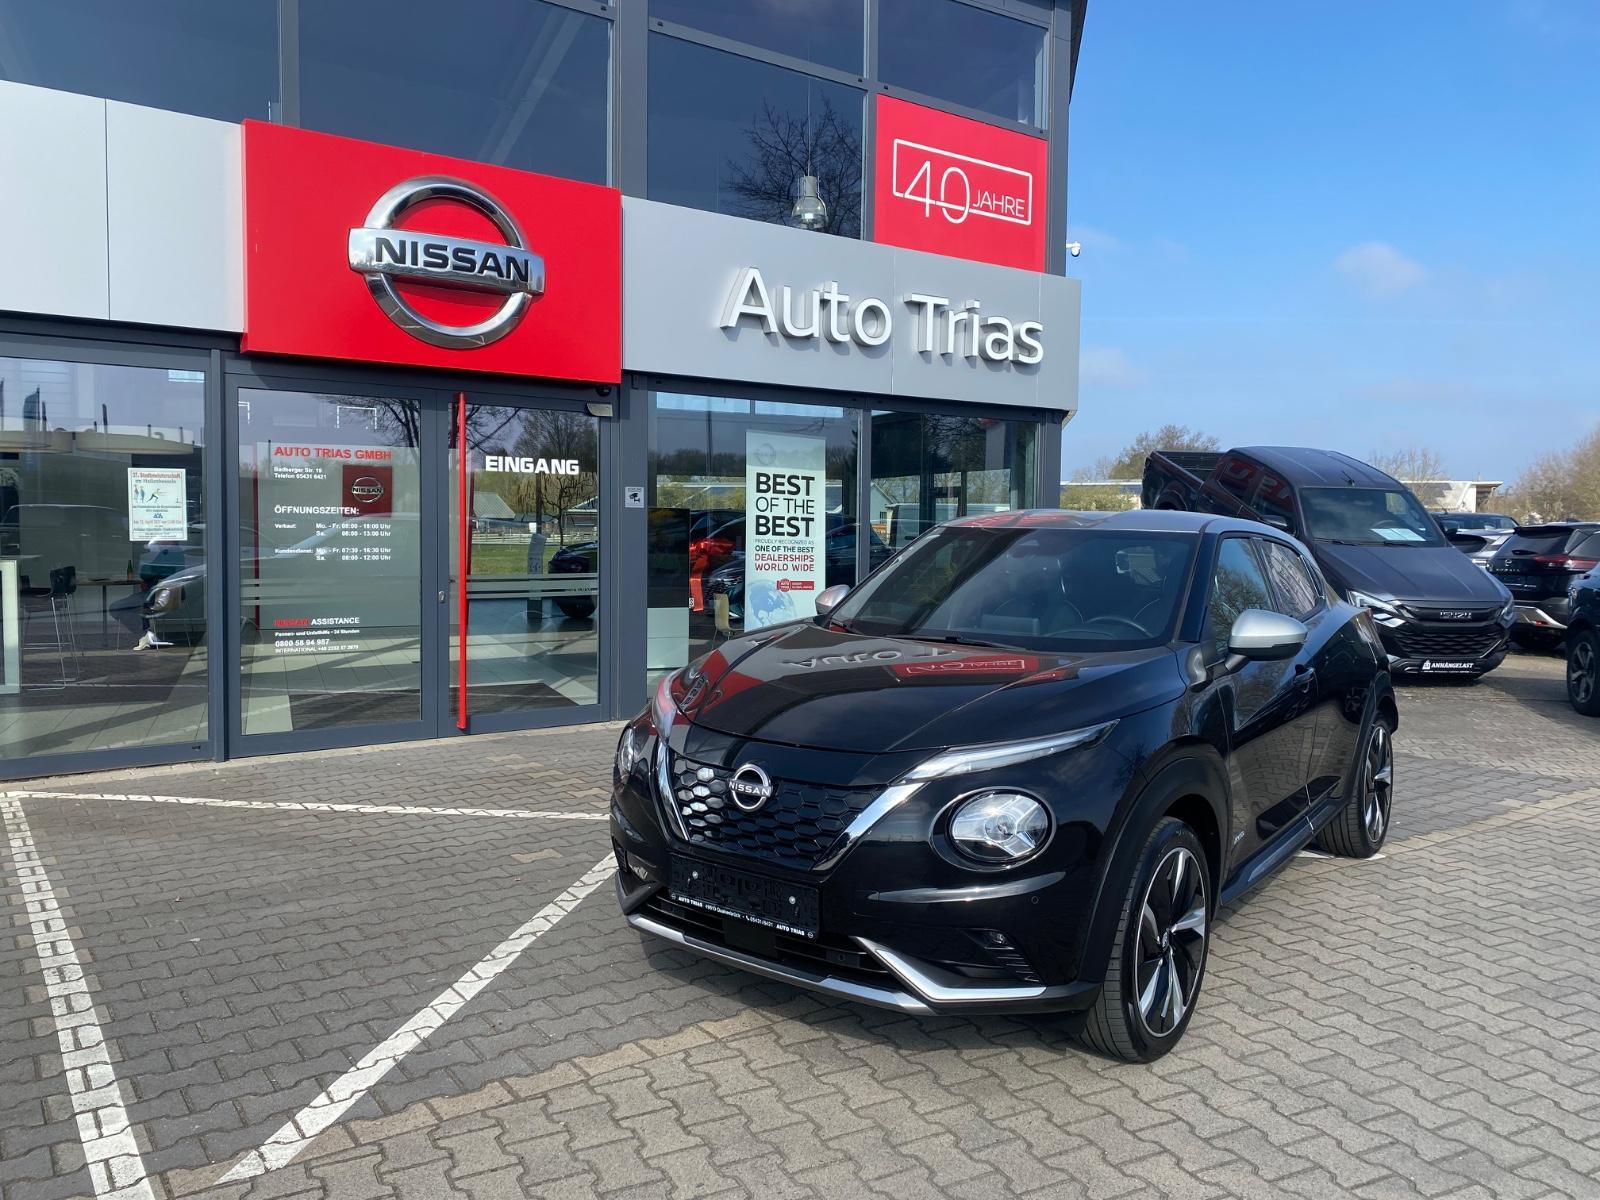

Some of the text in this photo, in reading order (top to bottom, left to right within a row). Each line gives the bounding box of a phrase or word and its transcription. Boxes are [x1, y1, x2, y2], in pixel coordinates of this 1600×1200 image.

[904, 160, 1025, 224] 40 JAHRE
[375, 237, 529, 282] NISSAN
[719, 266, 1044, 365] Auto Trias
[274, 446, 392, 460] AUTO TRIAS GMBH
[485, 455, 580, 476] EINGANG
[756, 472, 815, 496] BEST
[274, 505, 360, 515] ÖFFNUNGSZEITEN:
[756, 496, 815, 515] OF THE
[755, 515, 815, 537] BEST
[755, 554, 814, 562] DEALERSHIPS
[755, 563, 814, 572] WORLD WIDE
[311, 617, 360, 626] ASSISTANCE
[728, 782, 770, 796] NISSAN
